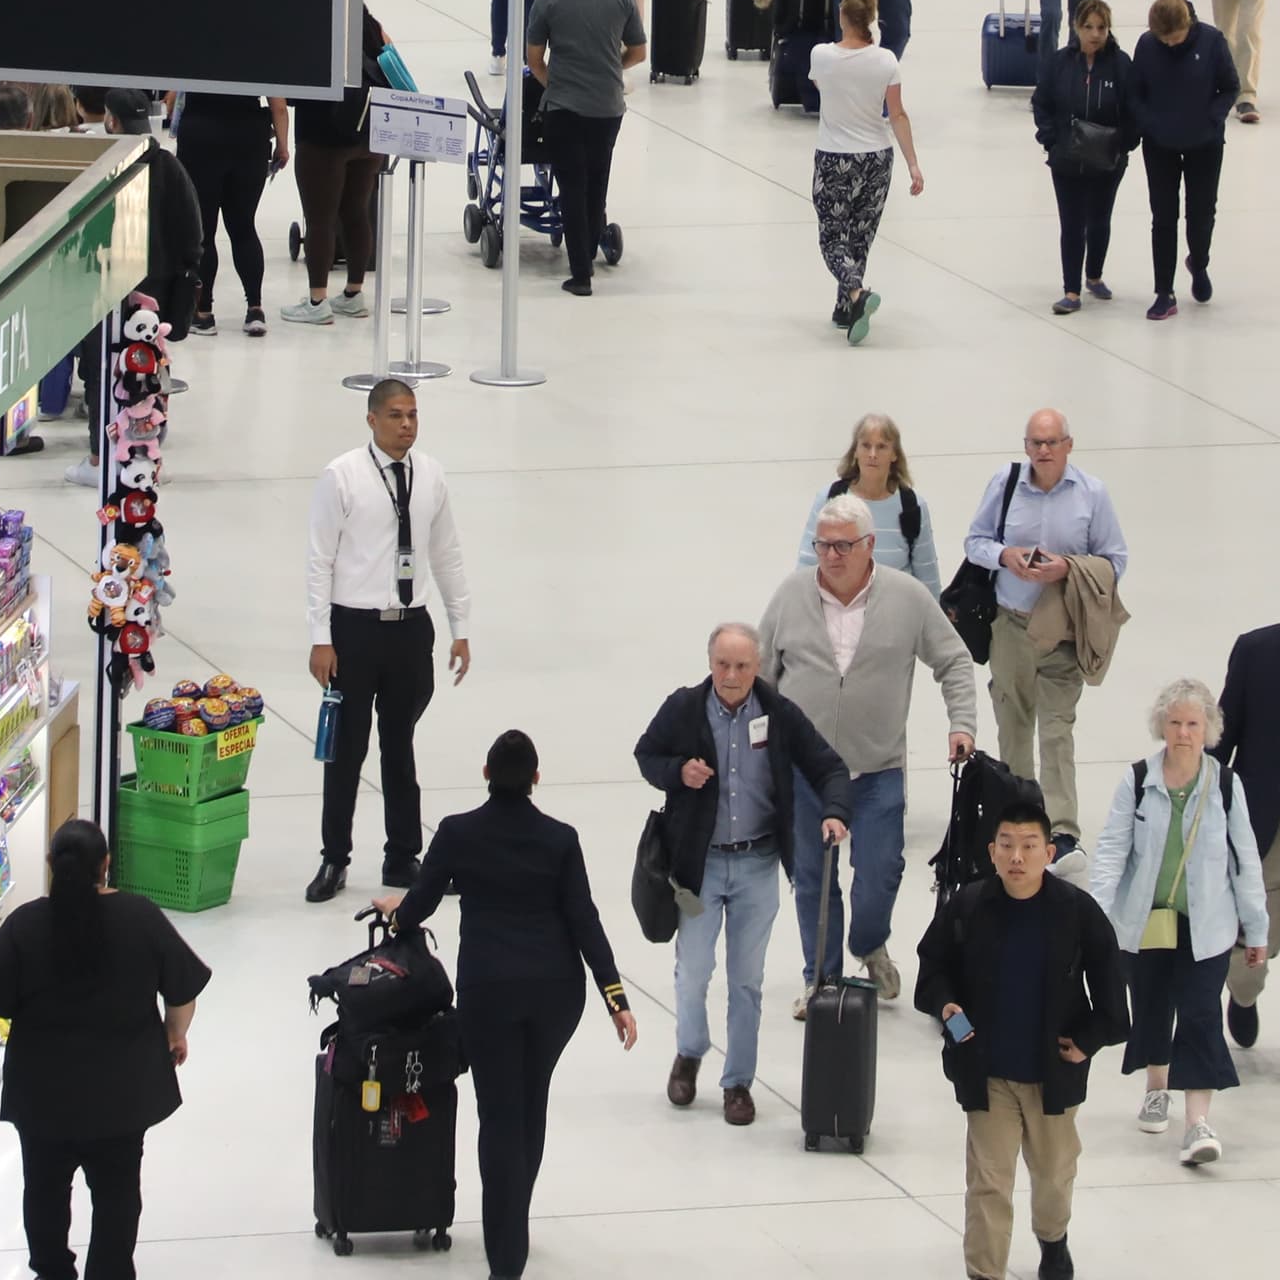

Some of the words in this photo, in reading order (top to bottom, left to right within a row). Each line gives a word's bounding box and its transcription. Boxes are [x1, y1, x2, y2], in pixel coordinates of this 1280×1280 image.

[390, 94, 434, 106] CopaAirlines
[383, 111, 390, 123] 3
[415, 116, 420, 127] 1
[448, 120, 453, 131] 1
[223, 725, 250, 742] OFERTA
[220, 738, 256, 758] ESPECIAL
